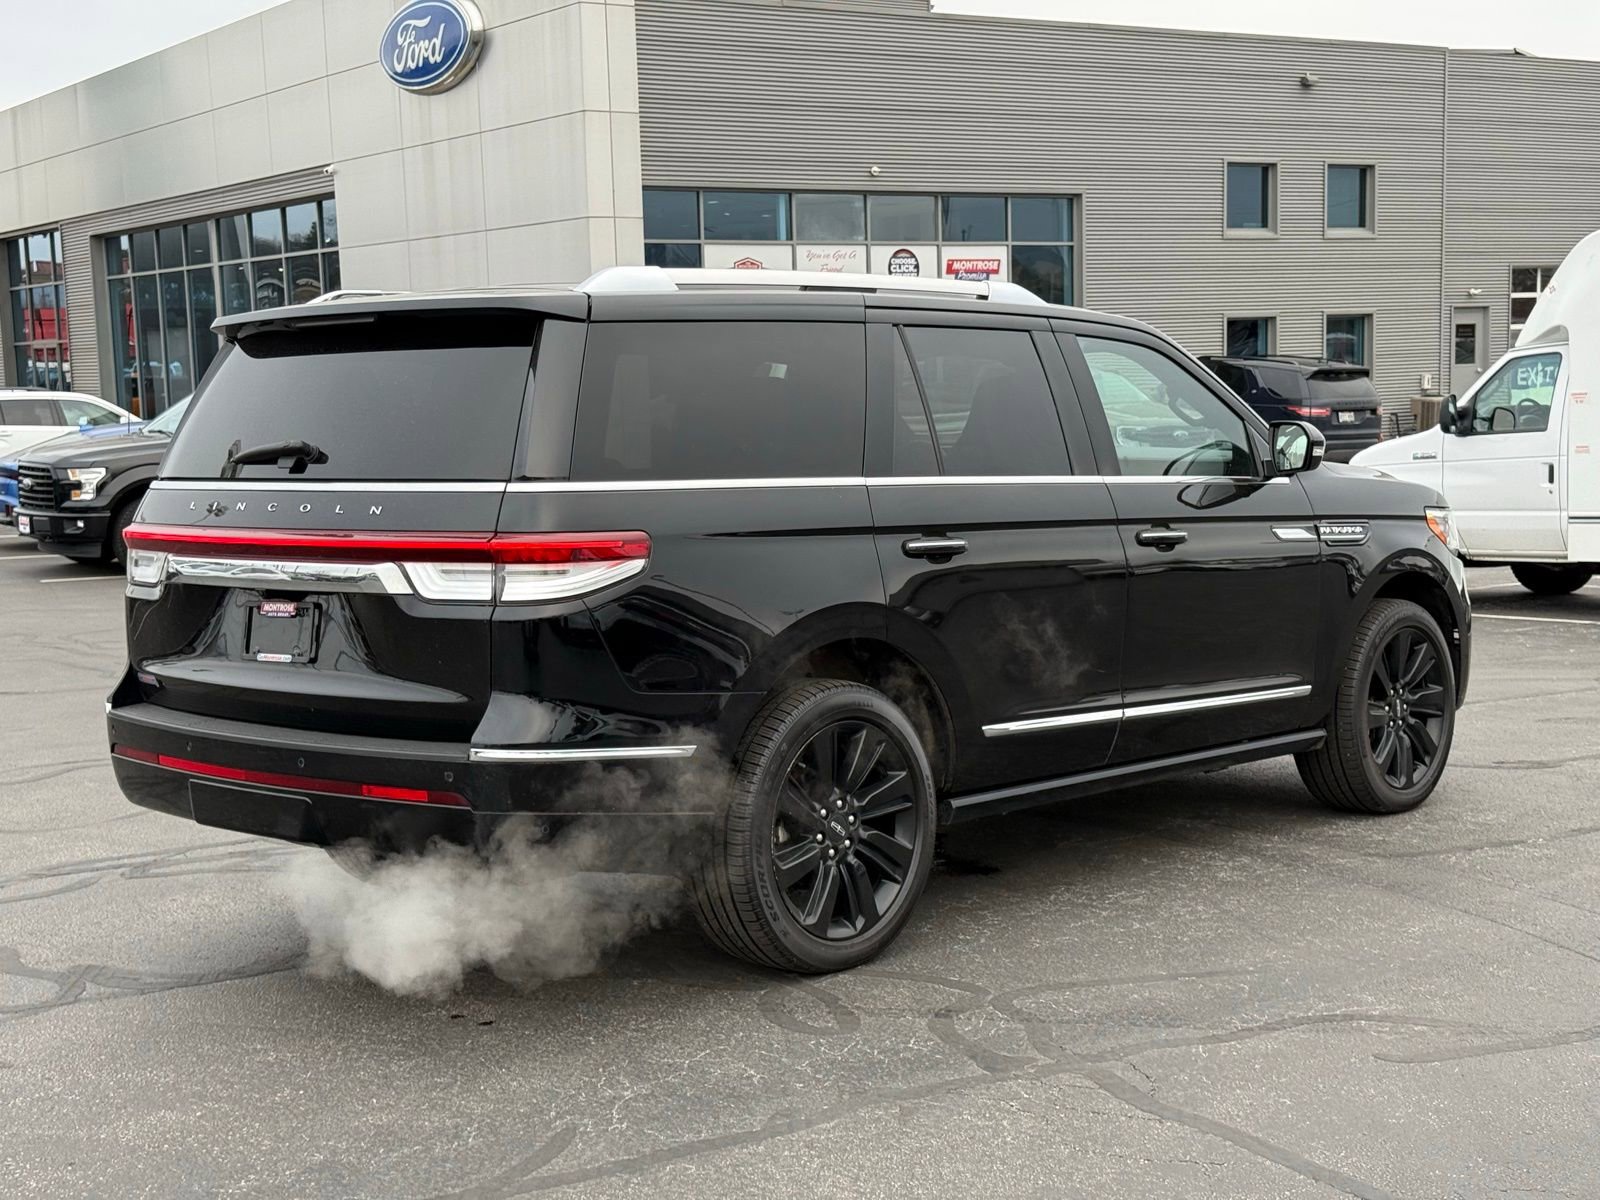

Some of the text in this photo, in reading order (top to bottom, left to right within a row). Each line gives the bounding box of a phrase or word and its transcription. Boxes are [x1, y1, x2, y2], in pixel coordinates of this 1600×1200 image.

[393, 15, 446, 74] Ford
[848, 249, 857, 260] A
[951, 260, 1000, 271] MONTROSE
[189, 501, 382, 515] LINCOLN
[262, 602, 295, 612] MONTROSE
